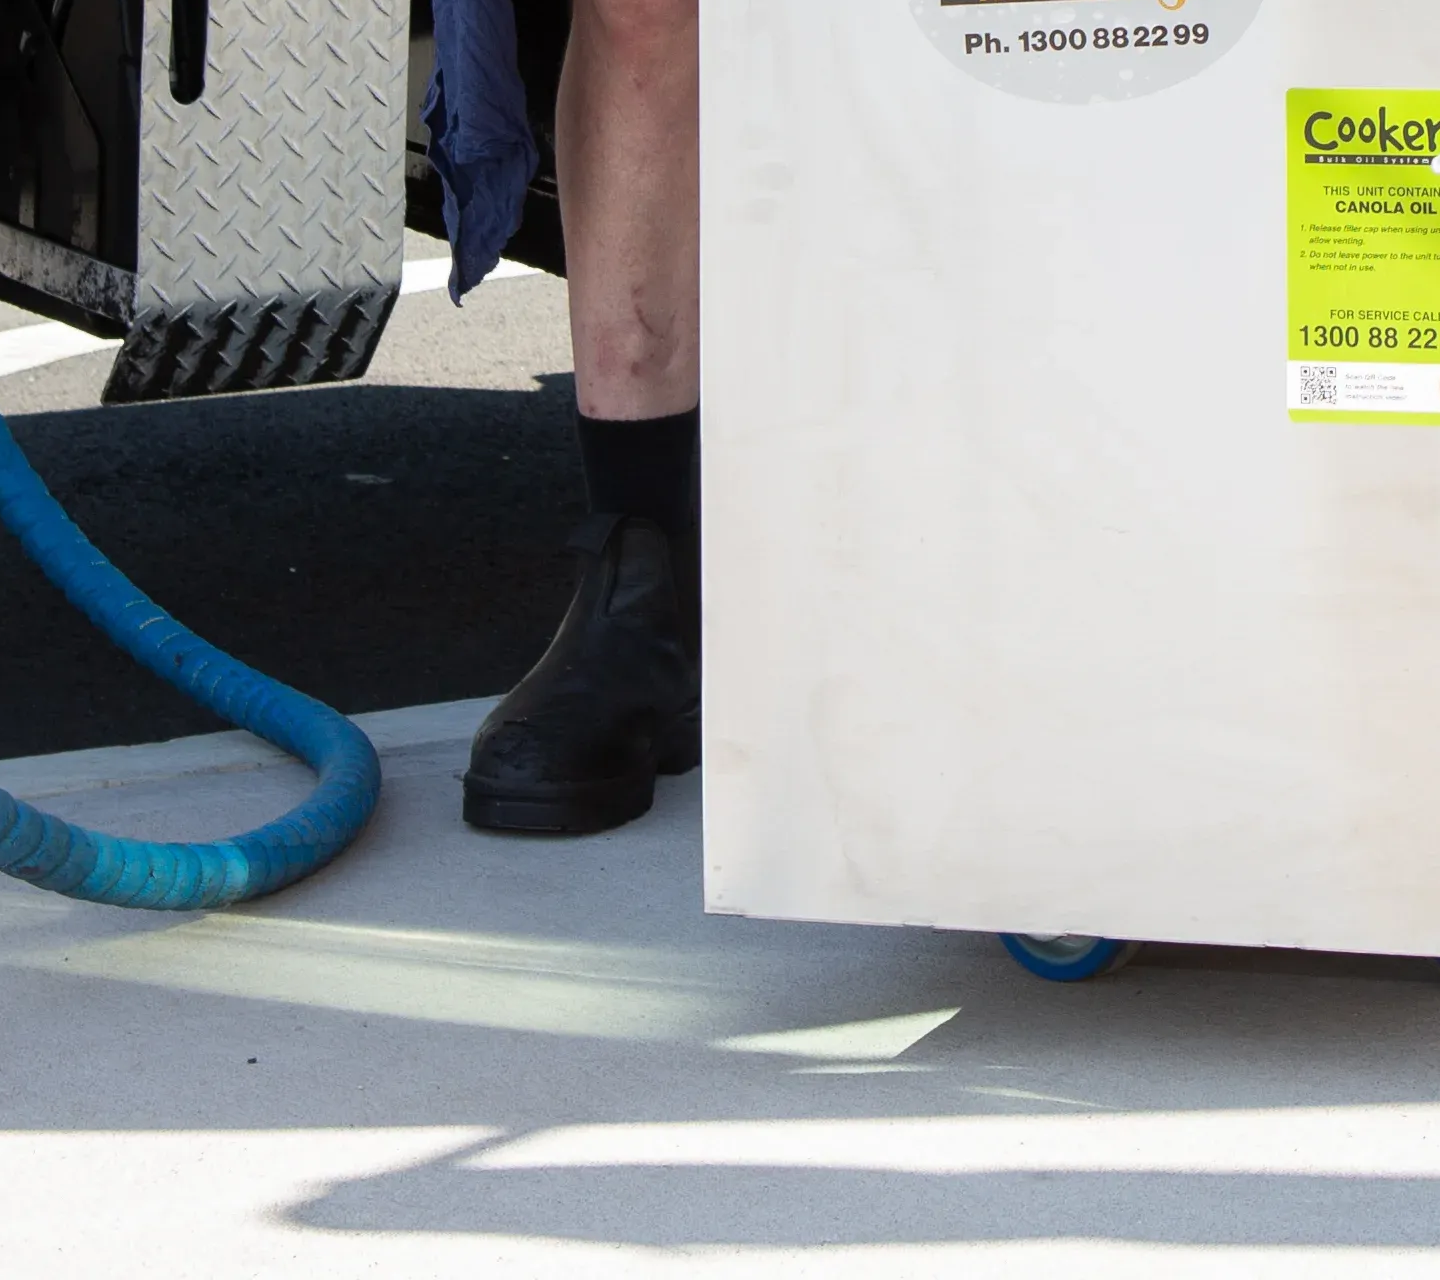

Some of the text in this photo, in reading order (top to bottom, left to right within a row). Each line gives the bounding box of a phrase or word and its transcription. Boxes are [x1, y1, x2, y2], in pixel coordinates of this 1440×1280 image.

[965, 32, 1010, 55] Ph.
[1018, 28, 1087, 52] 1300
[1383, 156, 1430, 165] System
[1323, 185, 1350, 196] THIS
[1357, 186, 1384, 197] UNIT
[1335, 200, 1438, 215] CANOLA OIL
[1309, 224, 1342, 233] Release
[1363, 226, 1379, 235] cap
[1381, 225, 1403, 233] when
[1405, 225, 1428, 236] using
[1309, 236, 1331, 244] allow
[1309, 250, 1321, 258] Do
[1322, 250, 1337, 259] not
[1338, 251, 1360, 259] leave
[1361, 252, 1388, 261] power
[1389, 251, 1398, 259] to
[1400, 251, 1413, 260] the
[1415, 252, 1432, 260] unit
[1309, 263, 1332, 271] when
[1333, 263, 1347, 271] not
[1349, 263, 1357, 271] in
[1330, 309, 1354, 320] FOR
[1358, 310, 1410, 321] SERVICE
[1299, 325, 1359, 348] 1300
[1368, 326, 1399, 349] 88
[1407, 327, 1438, 349] 22
